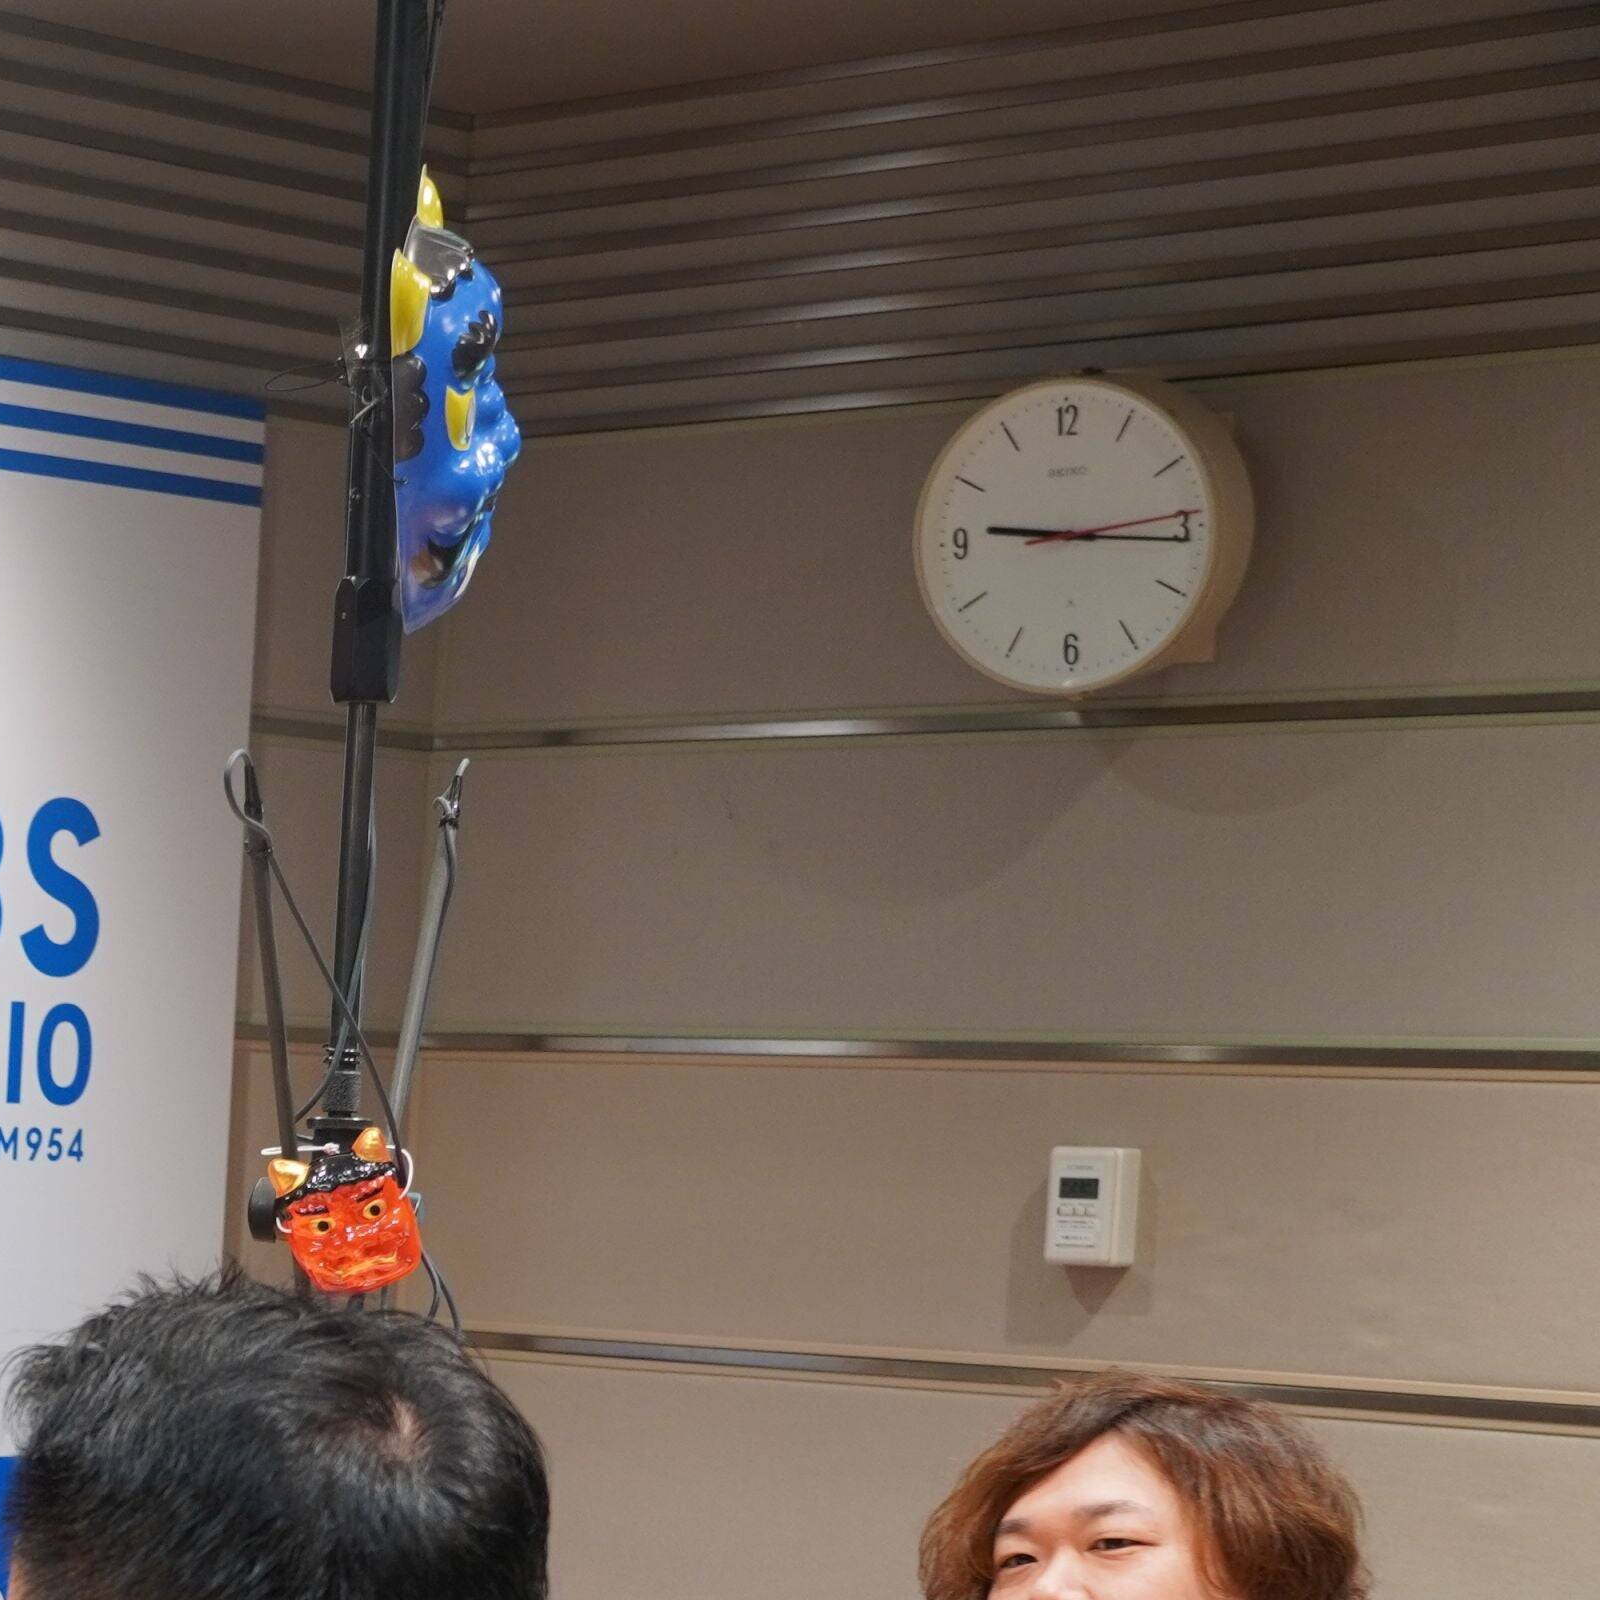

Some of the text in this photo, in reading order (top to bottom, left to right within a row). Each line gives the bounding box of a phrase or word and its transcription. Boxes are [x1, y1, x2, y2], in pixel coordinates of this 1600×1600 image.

[1056, 404, 1079, 436] 12
[952, 527, 969, 560] 9
[1062, 633, 1080, 666] 6
